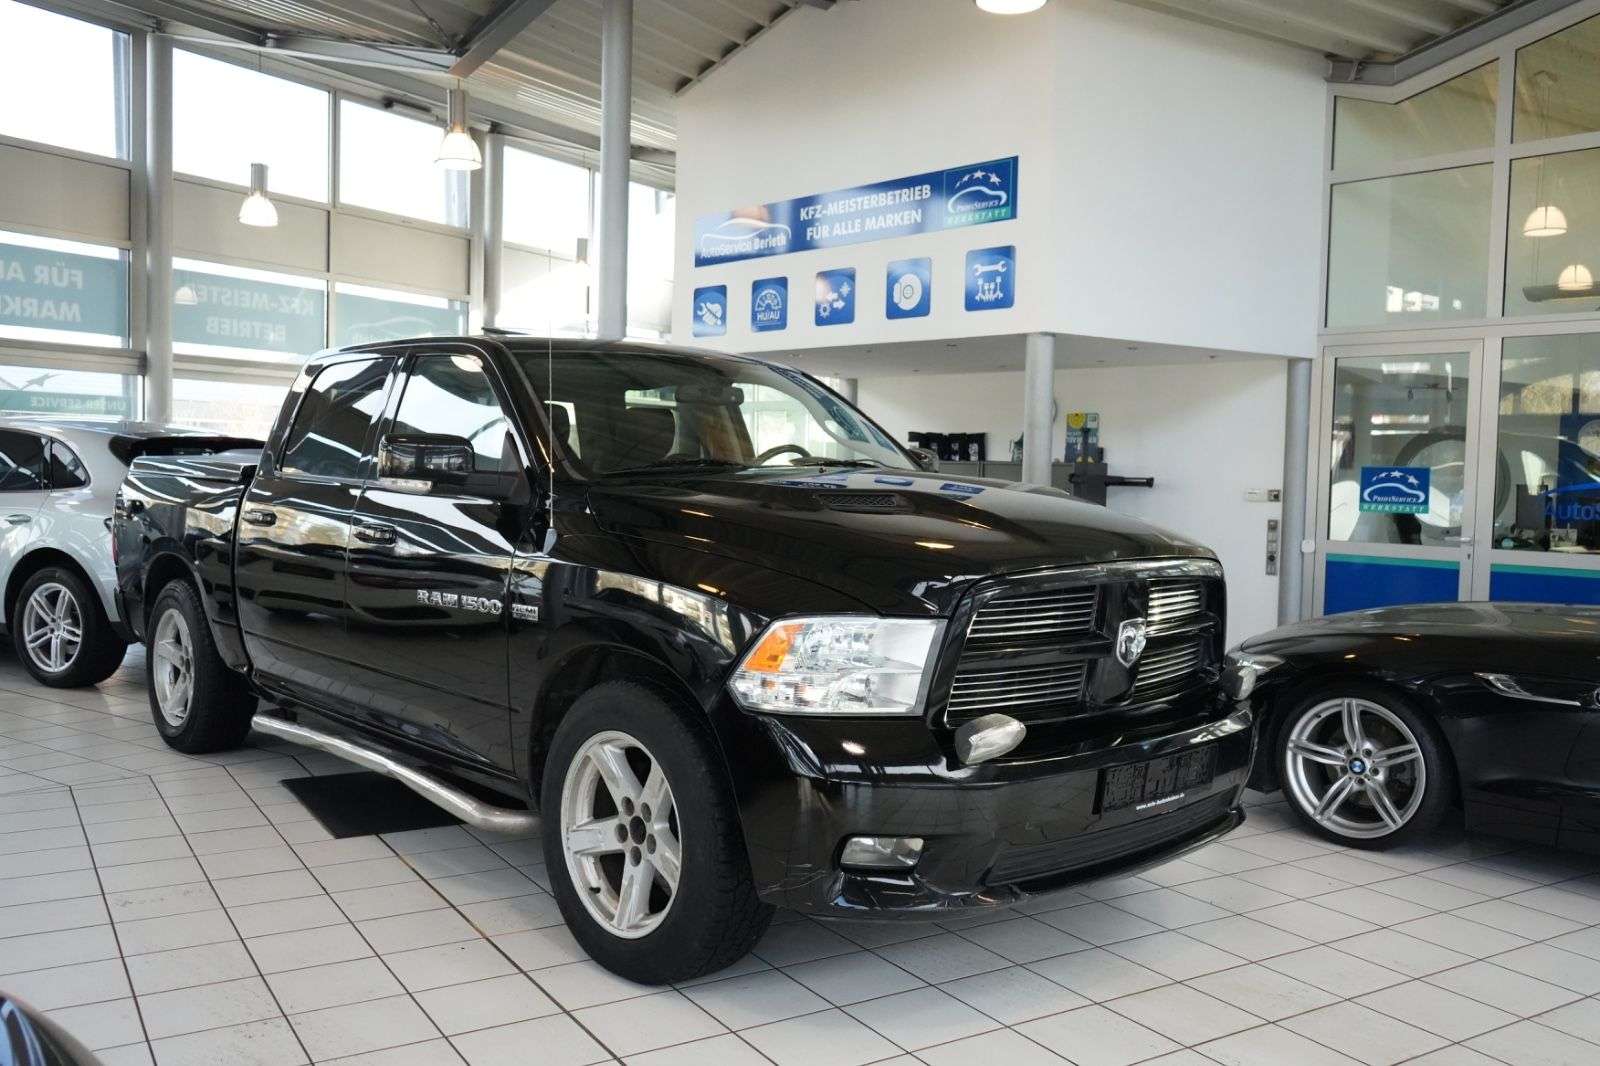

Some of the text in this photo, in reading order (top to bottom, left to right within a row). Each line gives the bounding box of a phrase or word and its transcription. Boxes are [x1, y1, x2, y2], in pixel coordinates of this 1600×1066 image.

[800, 185, 931, 221] KFZ-MEISTERBETRIEB
[806, 209, 922, 240] FÜR ALLE MARKEN
[416, 589, 503, 615] RAM 1500
